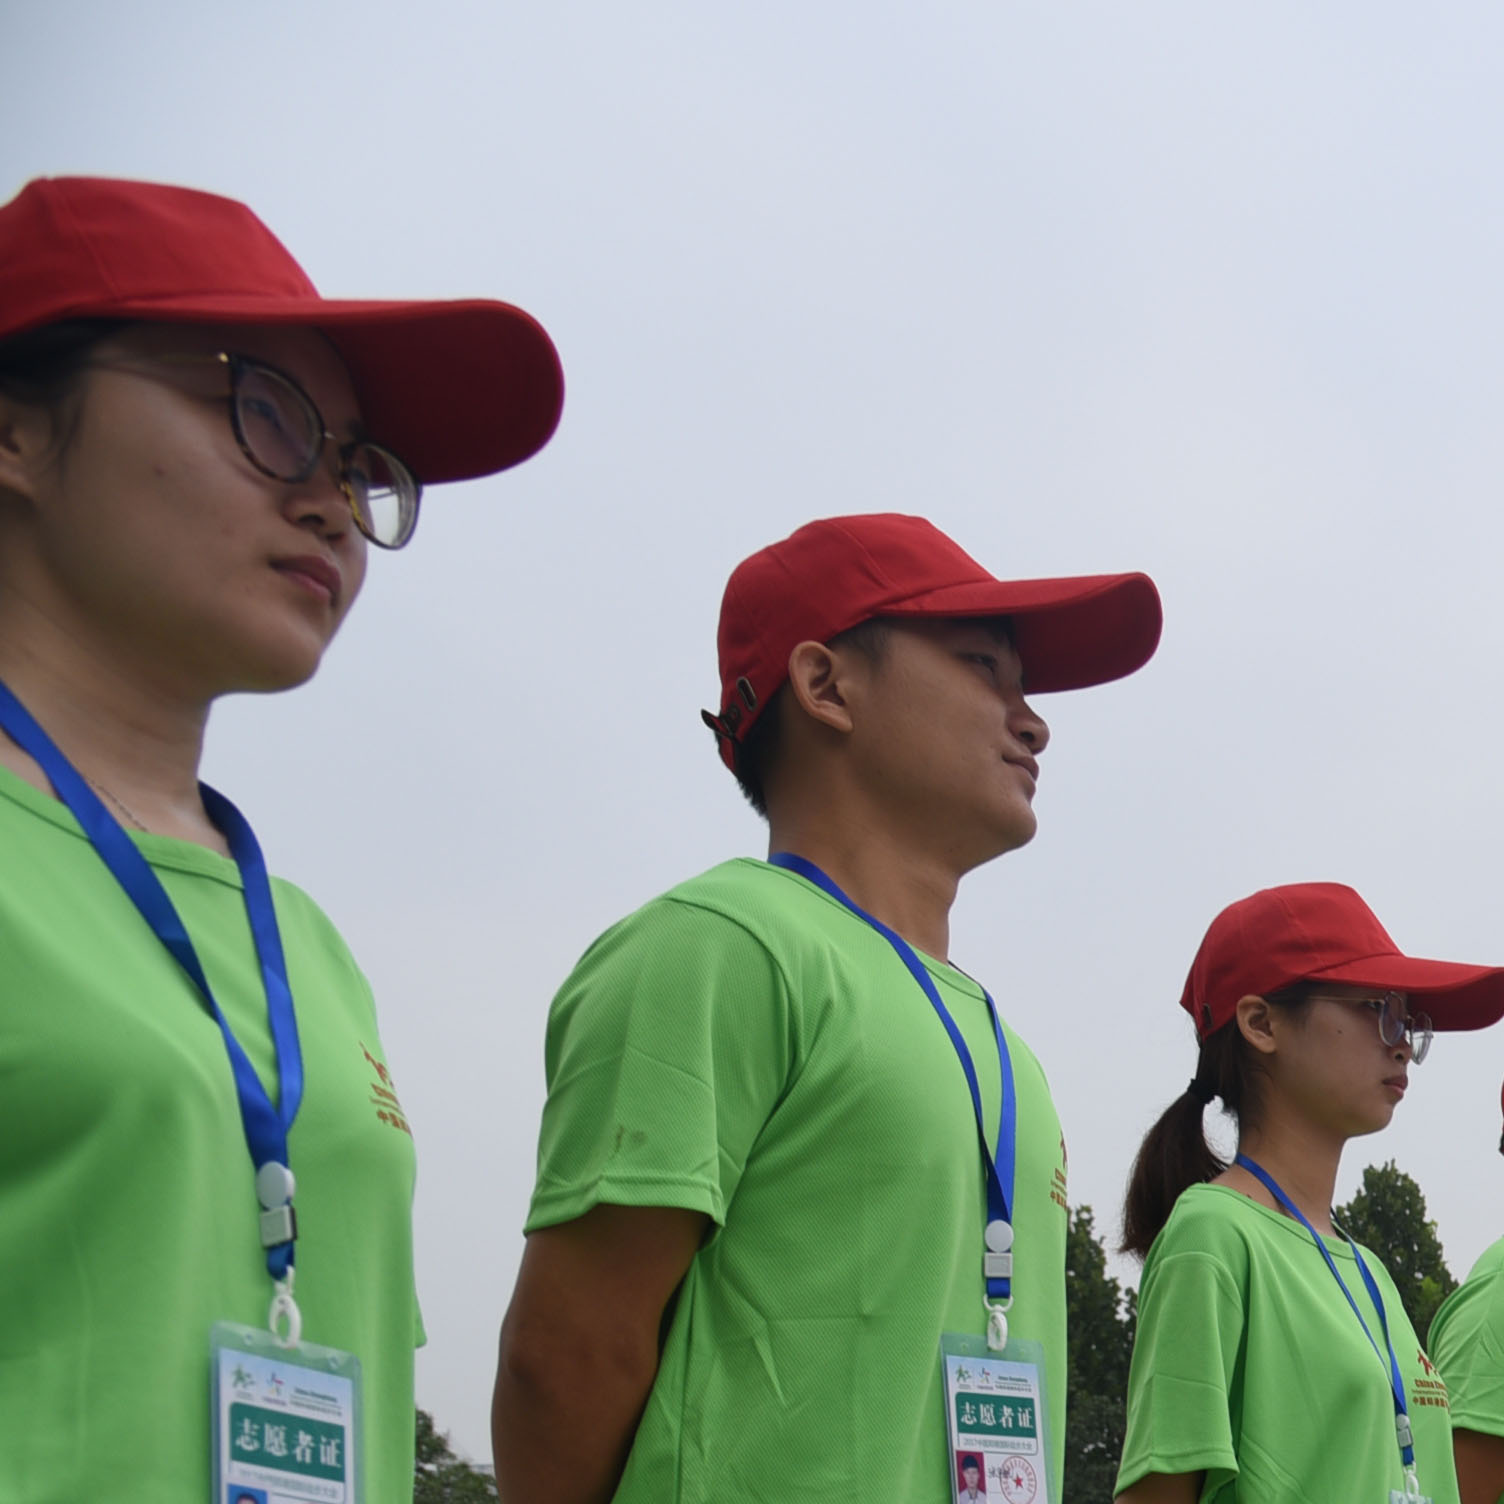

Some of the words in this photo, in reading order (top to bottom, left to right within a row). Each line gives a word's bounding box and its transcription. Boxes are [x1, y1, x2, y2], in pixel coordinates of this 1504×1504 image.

[961, 1401, 1034, 1429] 志愿者证
[235, 1417, 342, 1469] 志愿者证
